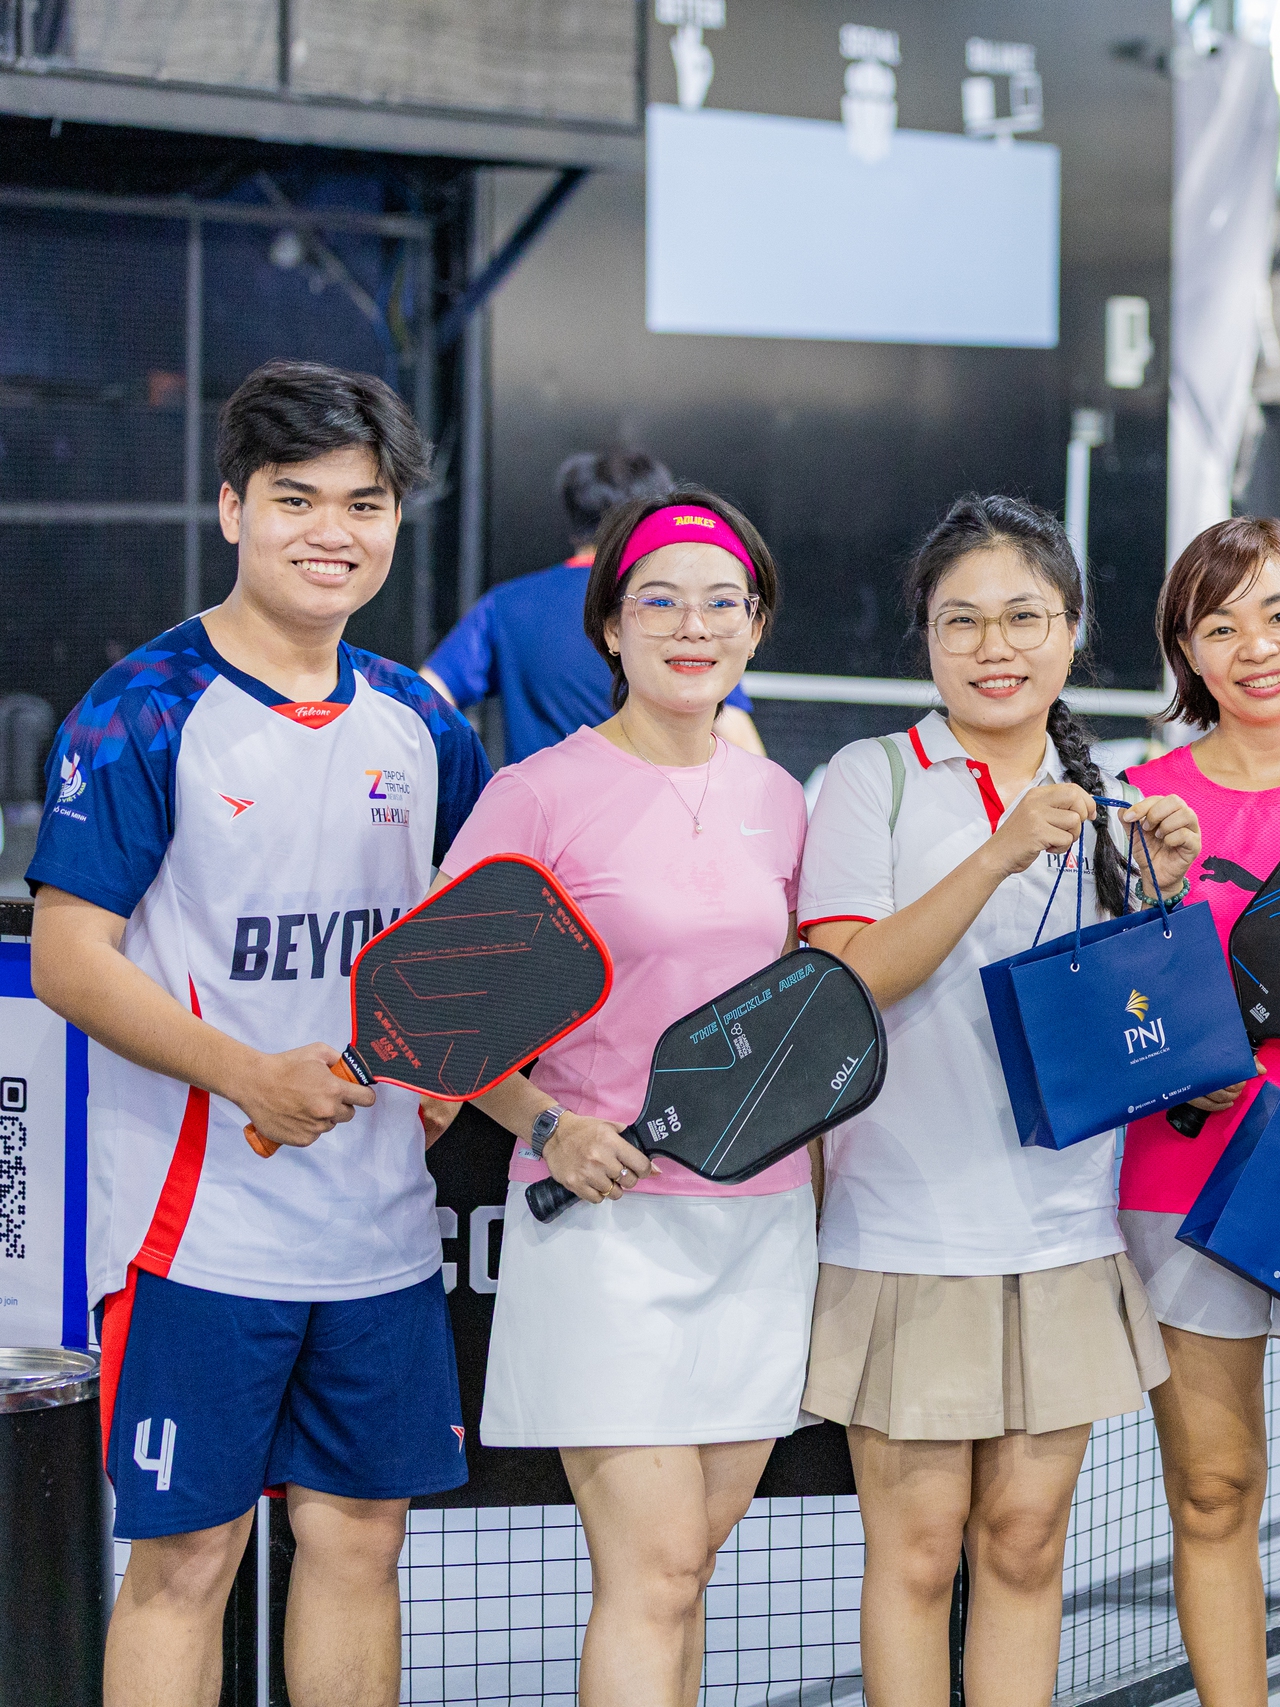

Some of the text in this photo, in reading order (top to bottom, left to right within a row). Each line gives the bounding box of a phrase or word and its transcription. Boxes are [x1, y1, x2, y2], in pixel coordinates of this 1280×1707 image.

[295, 706, 331, 717] Falcons
[71, 811, 87, 822] MINH
[556, 907, 584, 943] TOUR
[229, 907, 413, 981] BEYO
[689, 963, 815, 1045] THE PICKLE AREA
[1255, 1002, 1270, 1020] USA
[374, 1011, 422, 1069] AMAKIRK
[380, 1037, 398, 1059] USA
[1123, 1017, 1166, 1054] PNJ
[343, 1052, 369, 1085] AMAKIRK
[830, 1055, 858, 1090] T700
[655, 1118, 669, 1140] USA
[664, 1105, 682, 1132] PRO
[133, 1417, 177, 1491] 4
